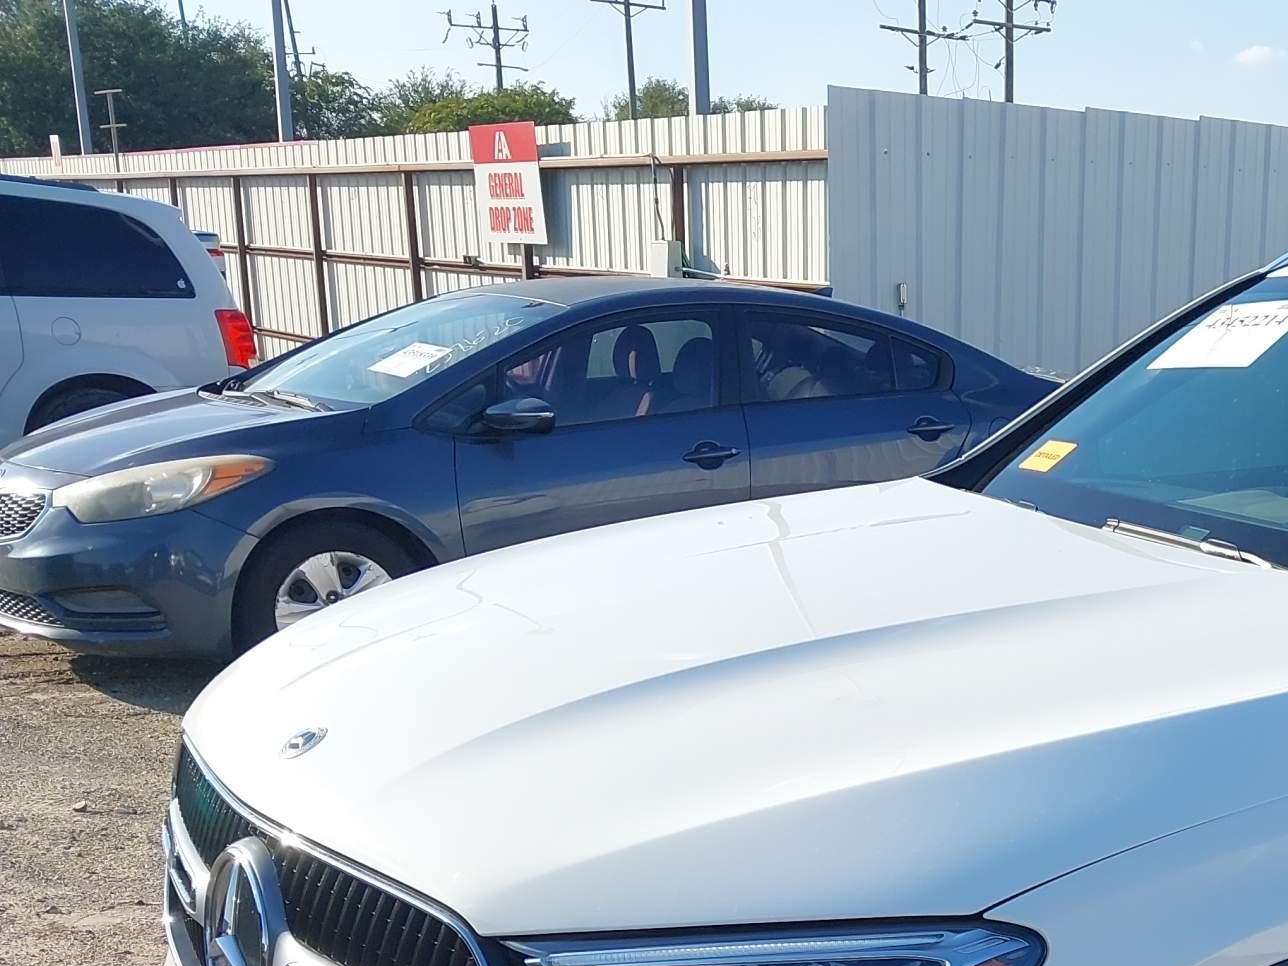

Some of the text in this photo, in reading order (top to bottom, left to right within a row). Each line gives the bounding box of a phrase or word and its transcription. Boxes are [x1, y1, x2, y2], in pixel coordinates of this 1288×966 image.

[488, 172, 525, 199] GENERAL
[489, 206, 535, 234] DROP ZONE
